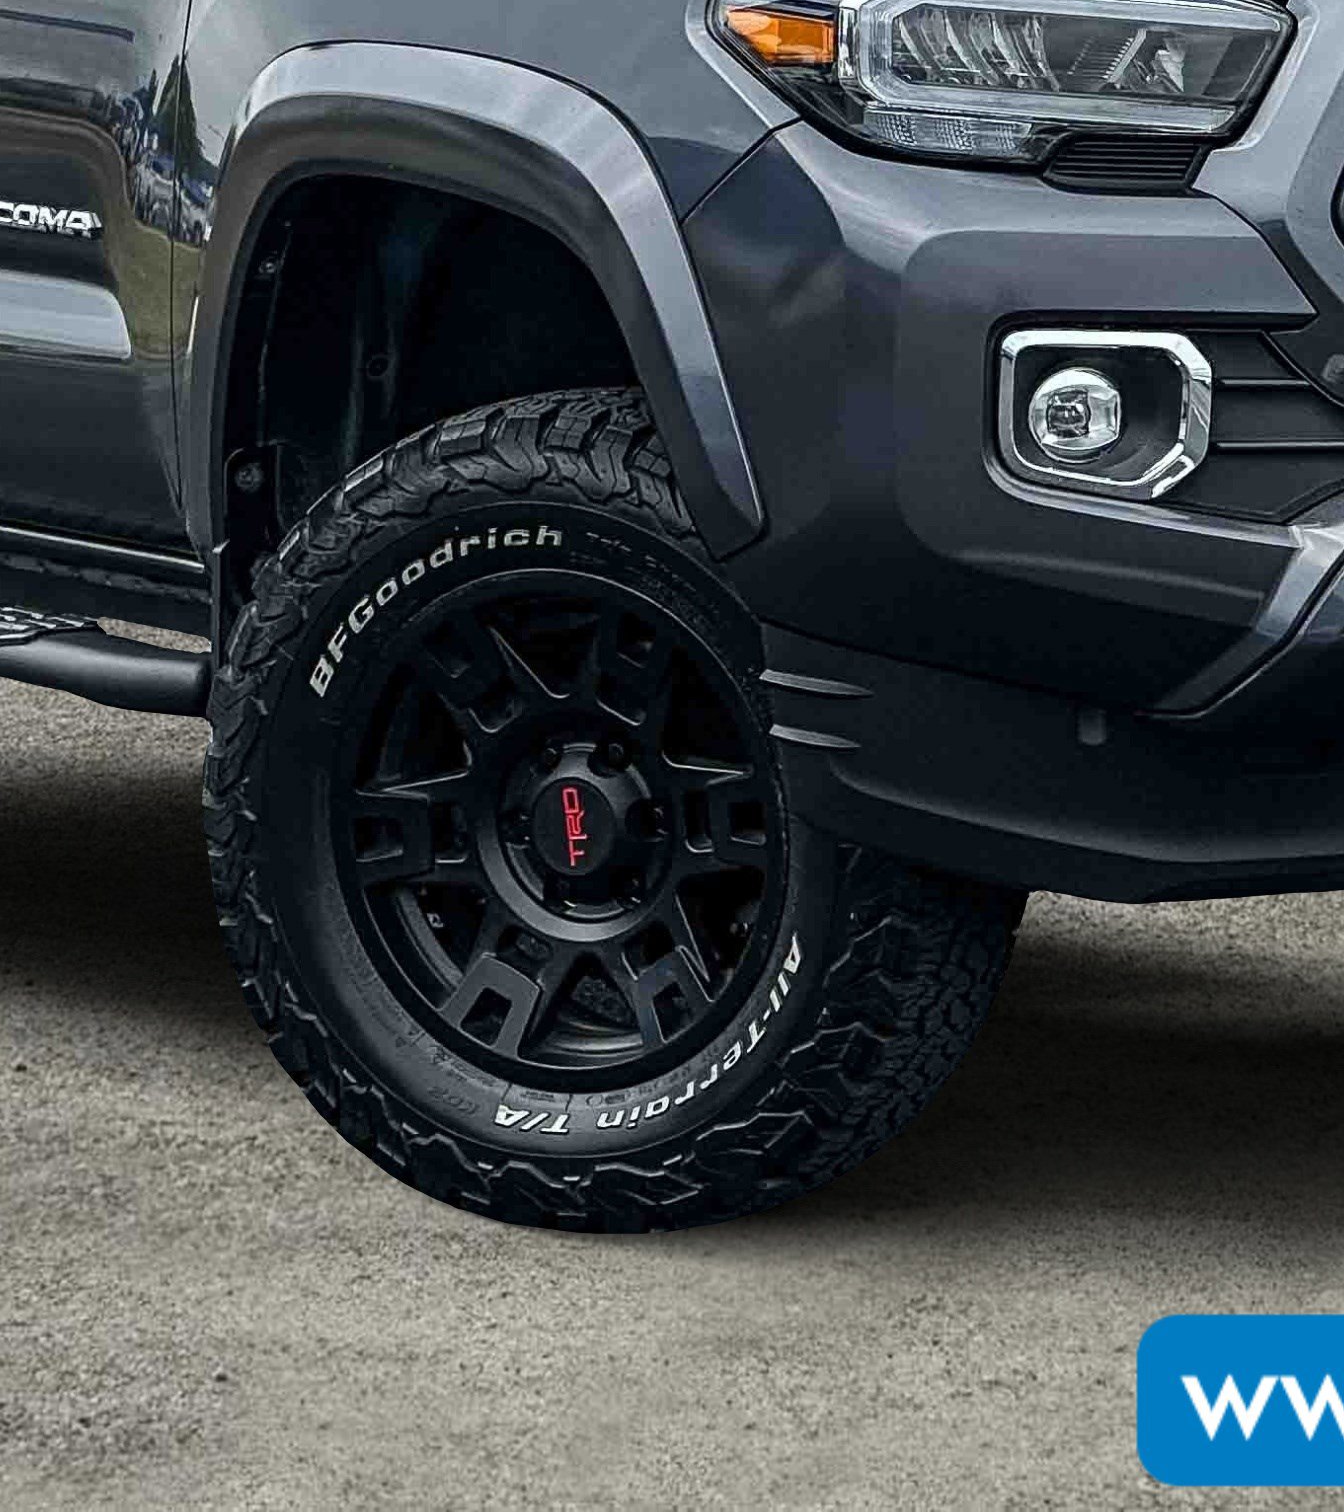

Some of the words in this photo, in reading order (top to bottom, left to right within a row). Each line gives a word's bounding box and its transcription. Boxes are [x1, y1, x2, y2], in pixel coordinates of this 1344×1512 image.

[309, 524, 563, 697] BFGoodrich
[562, 787, 587, 867] TRD
[595, 935, 802, 1130] All-Terrain
[494, 1103, 570, 1134] T/A
